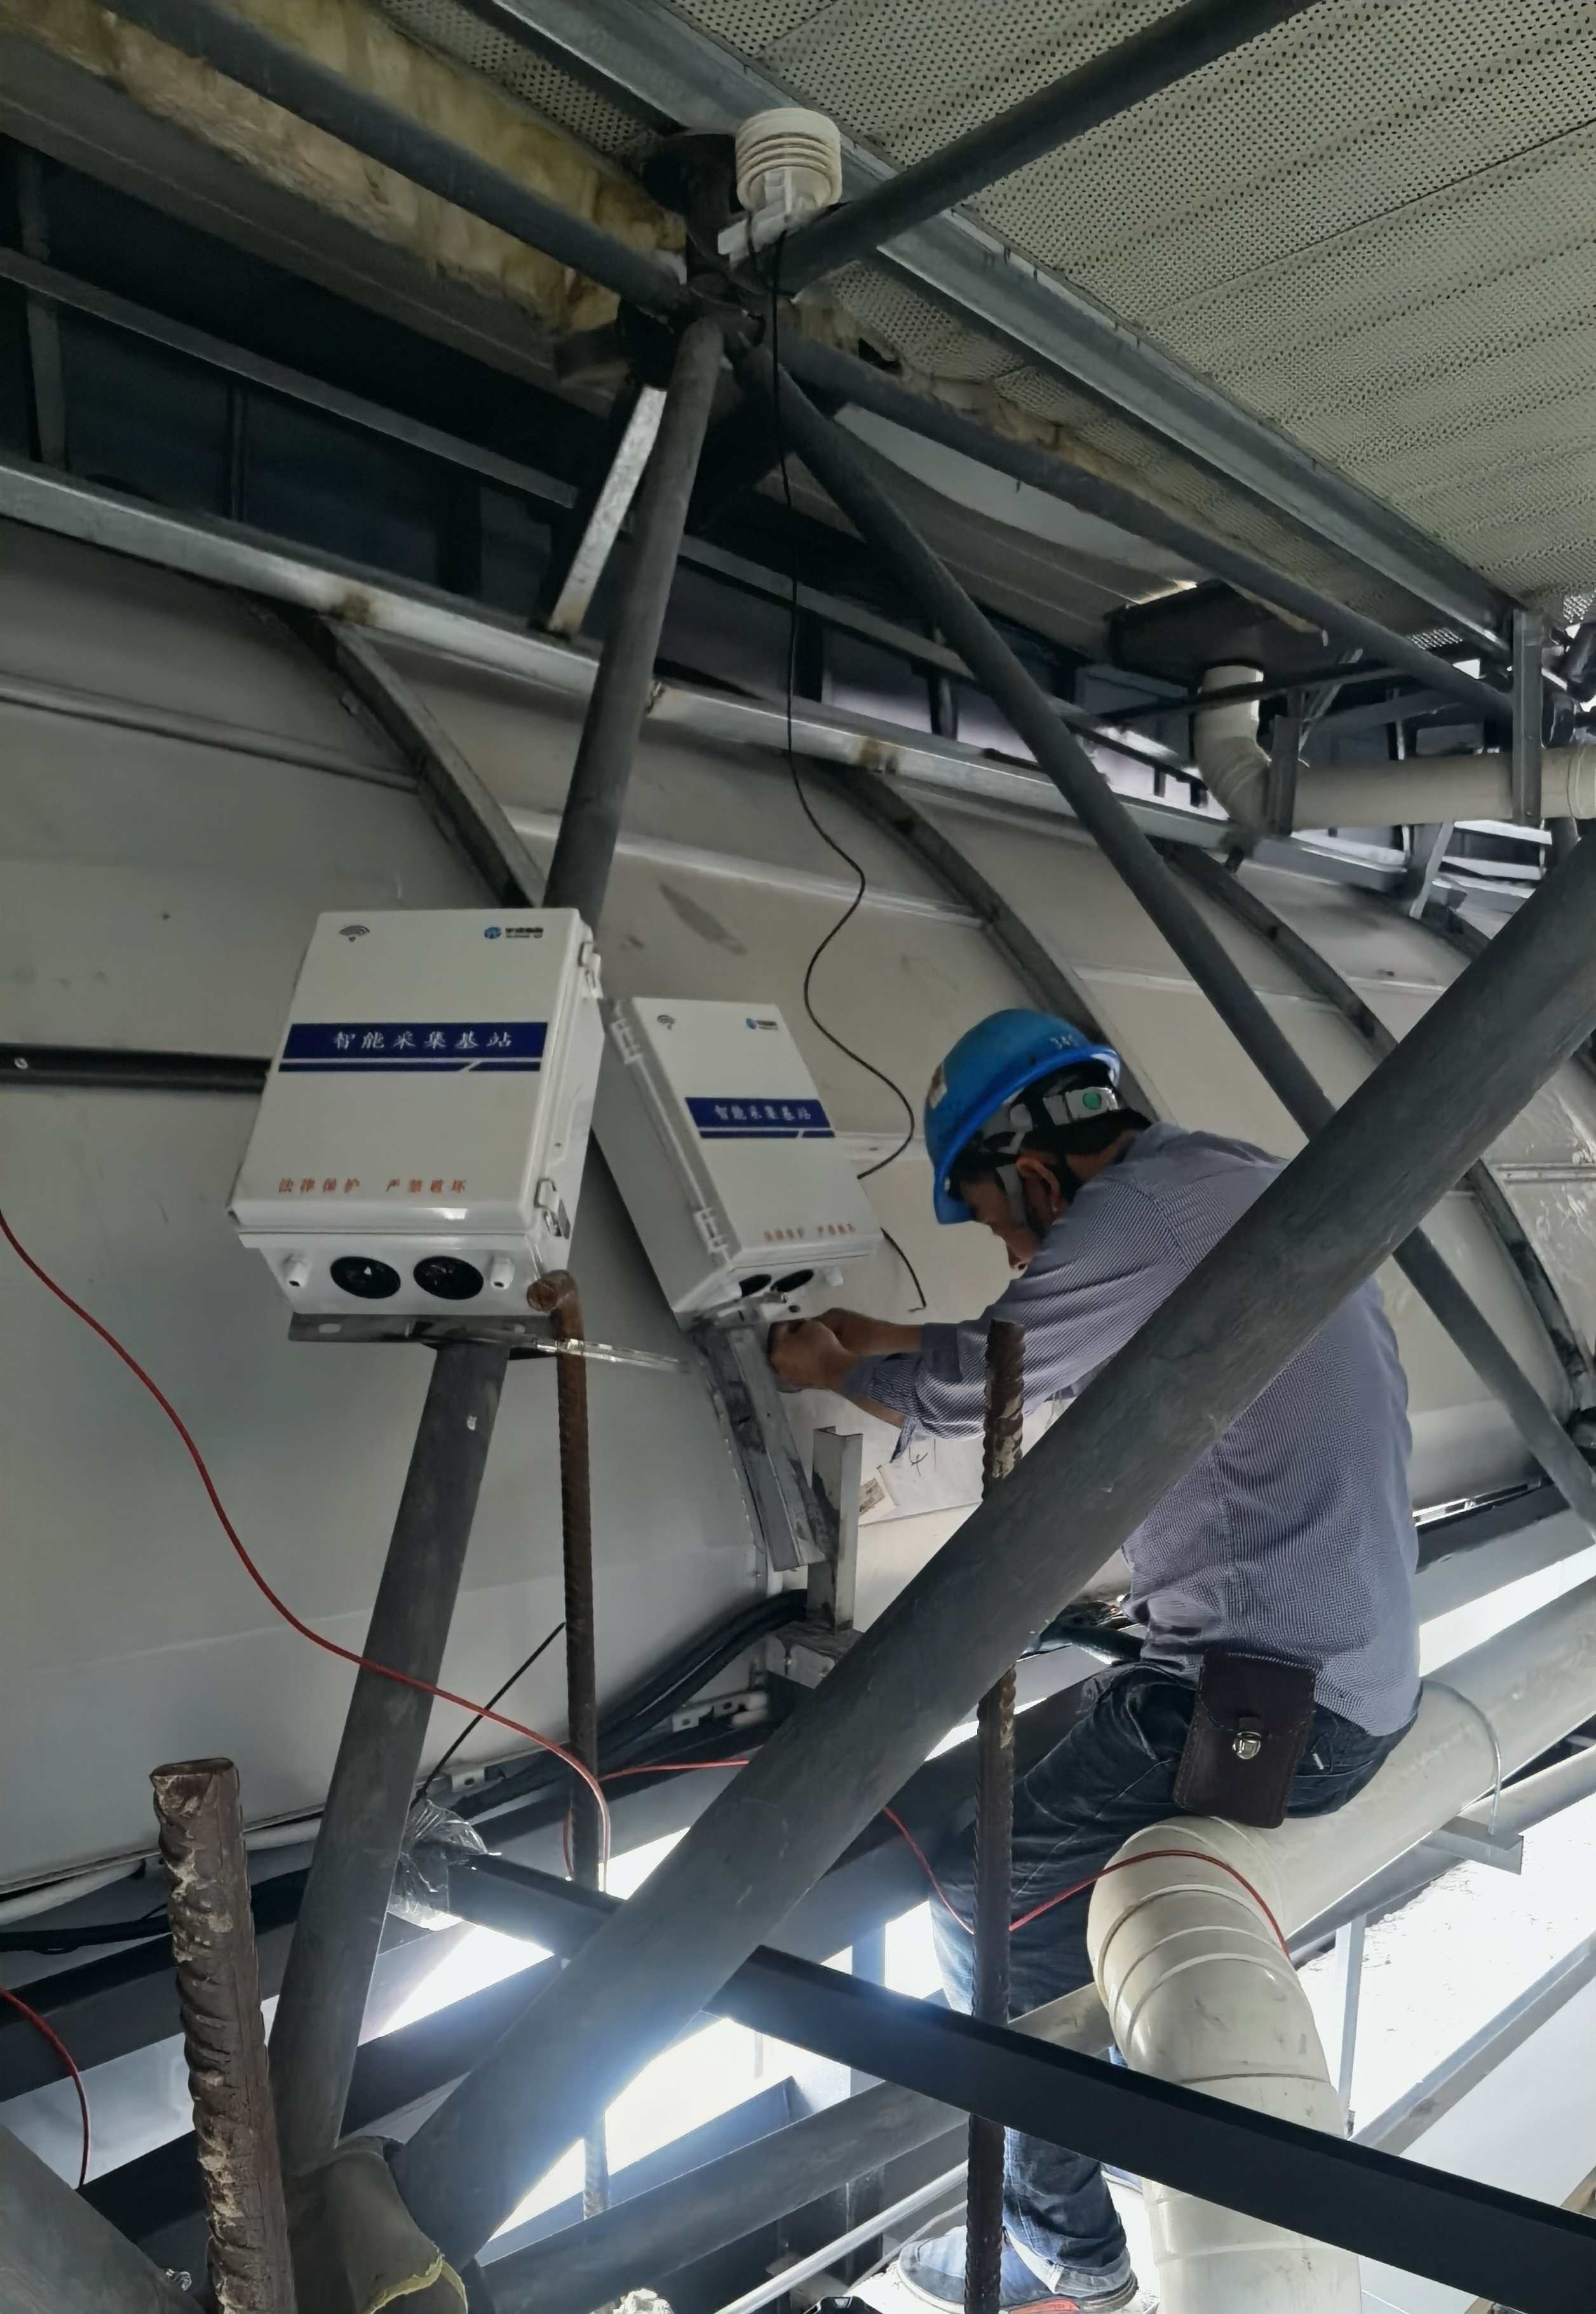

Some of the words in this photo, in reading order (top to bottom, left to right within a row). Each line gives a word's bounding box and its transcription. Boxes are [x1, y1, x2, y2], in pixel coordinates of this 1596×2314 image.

[334, 1031, 511, 1049] 智能采集基站
